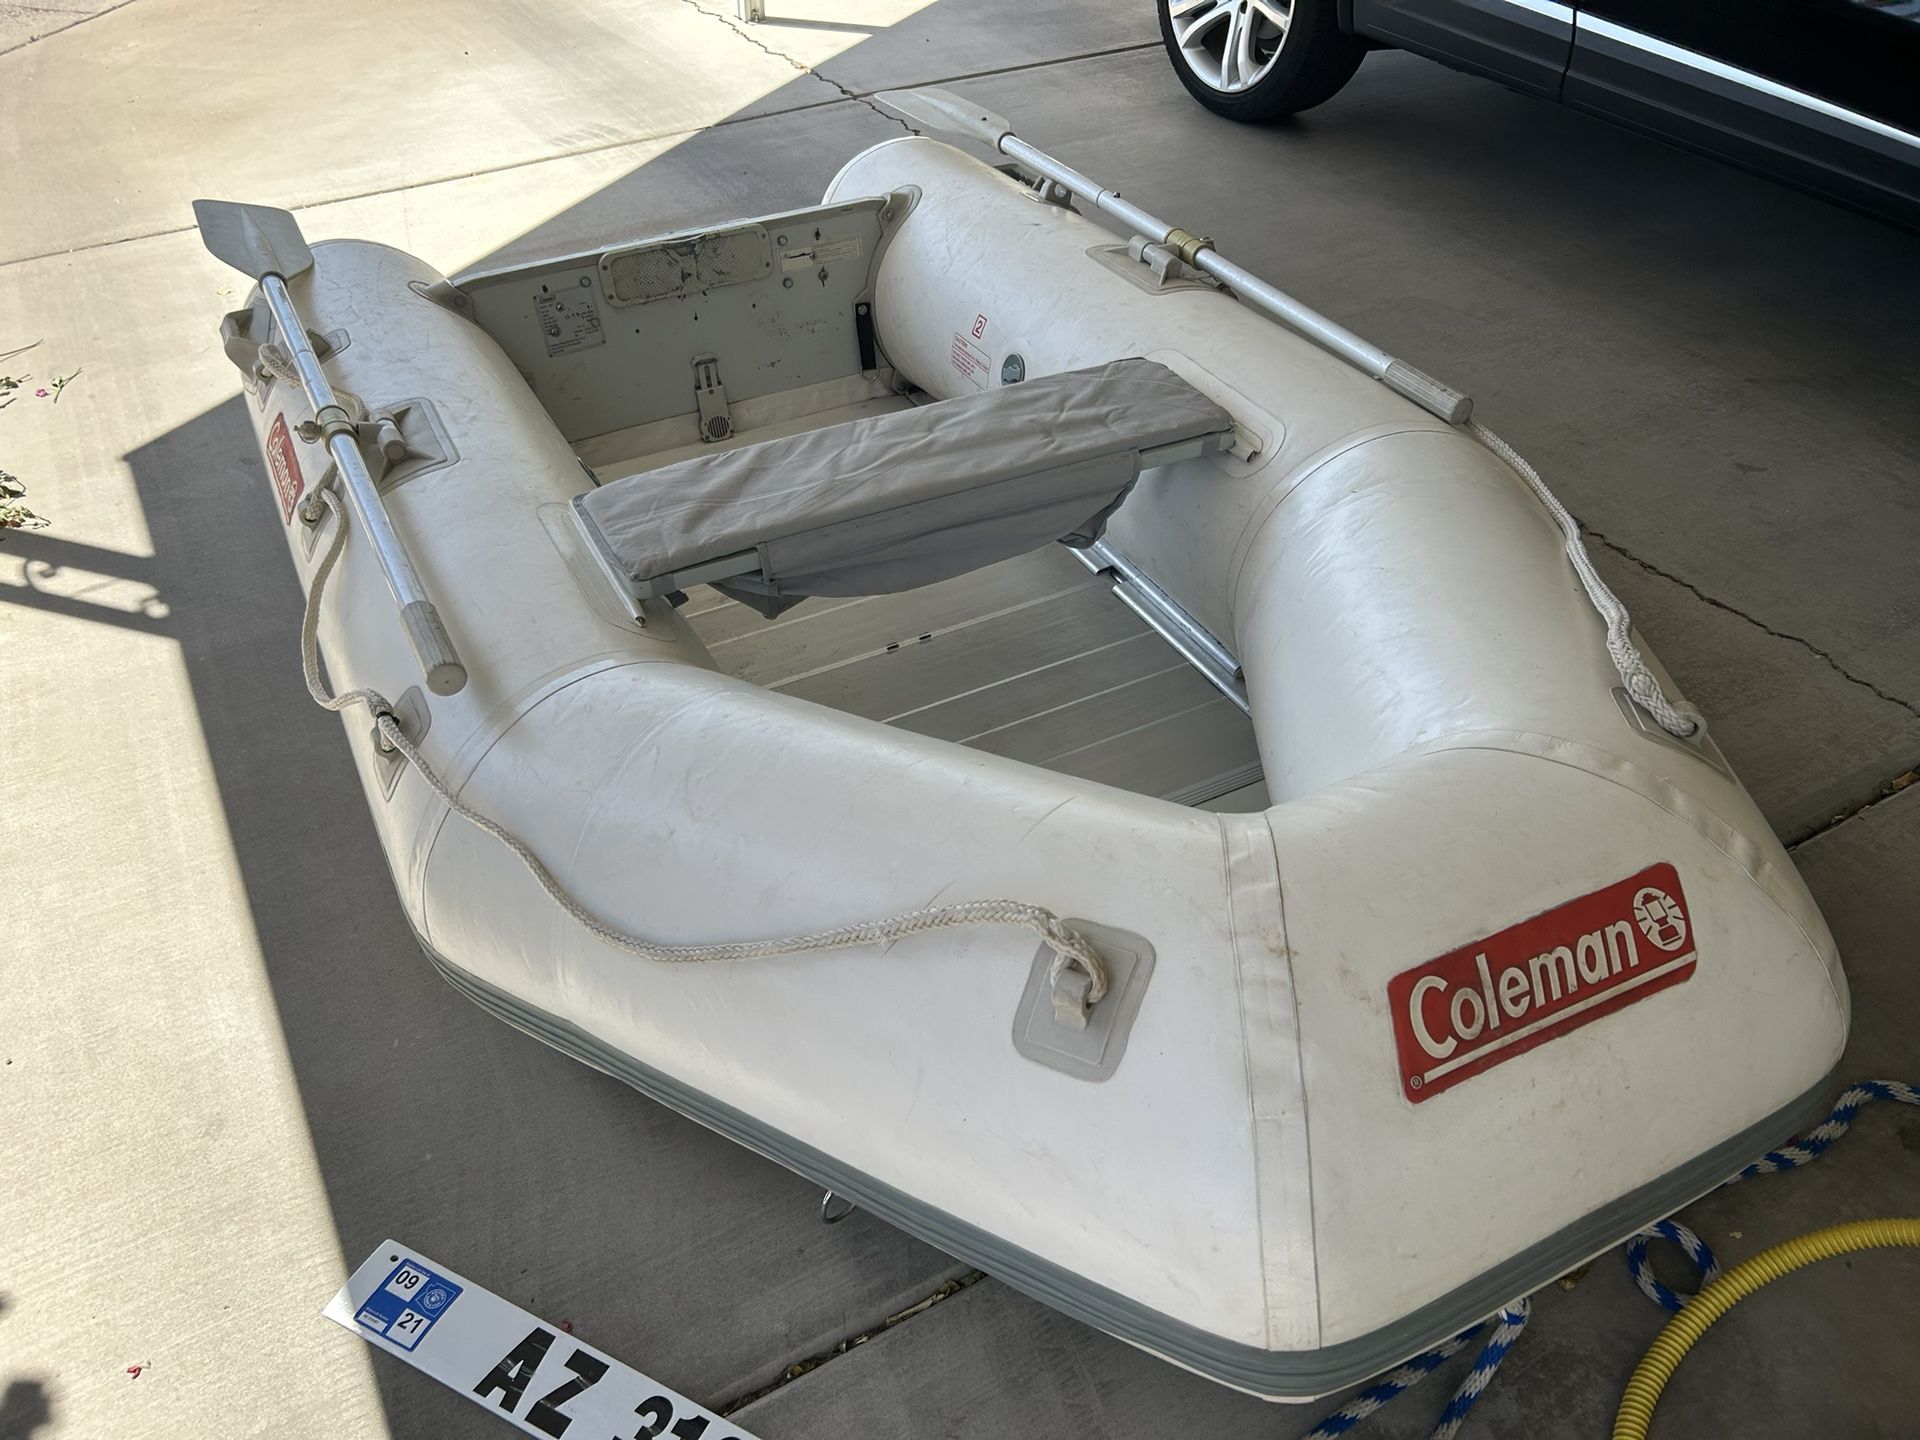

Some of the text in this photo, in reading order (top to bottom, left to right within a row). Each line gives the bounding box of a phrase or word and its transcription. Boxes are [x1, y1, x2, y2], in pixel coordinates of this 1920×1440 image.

[975, 320, 983, 334] 2
[1409, 919, 1639, 1059] Coleman
[395, 1270, 420, 1290] 09
[397, 1312, 424, 1334] 21
[472, 1326, 610, 1440] AZ
